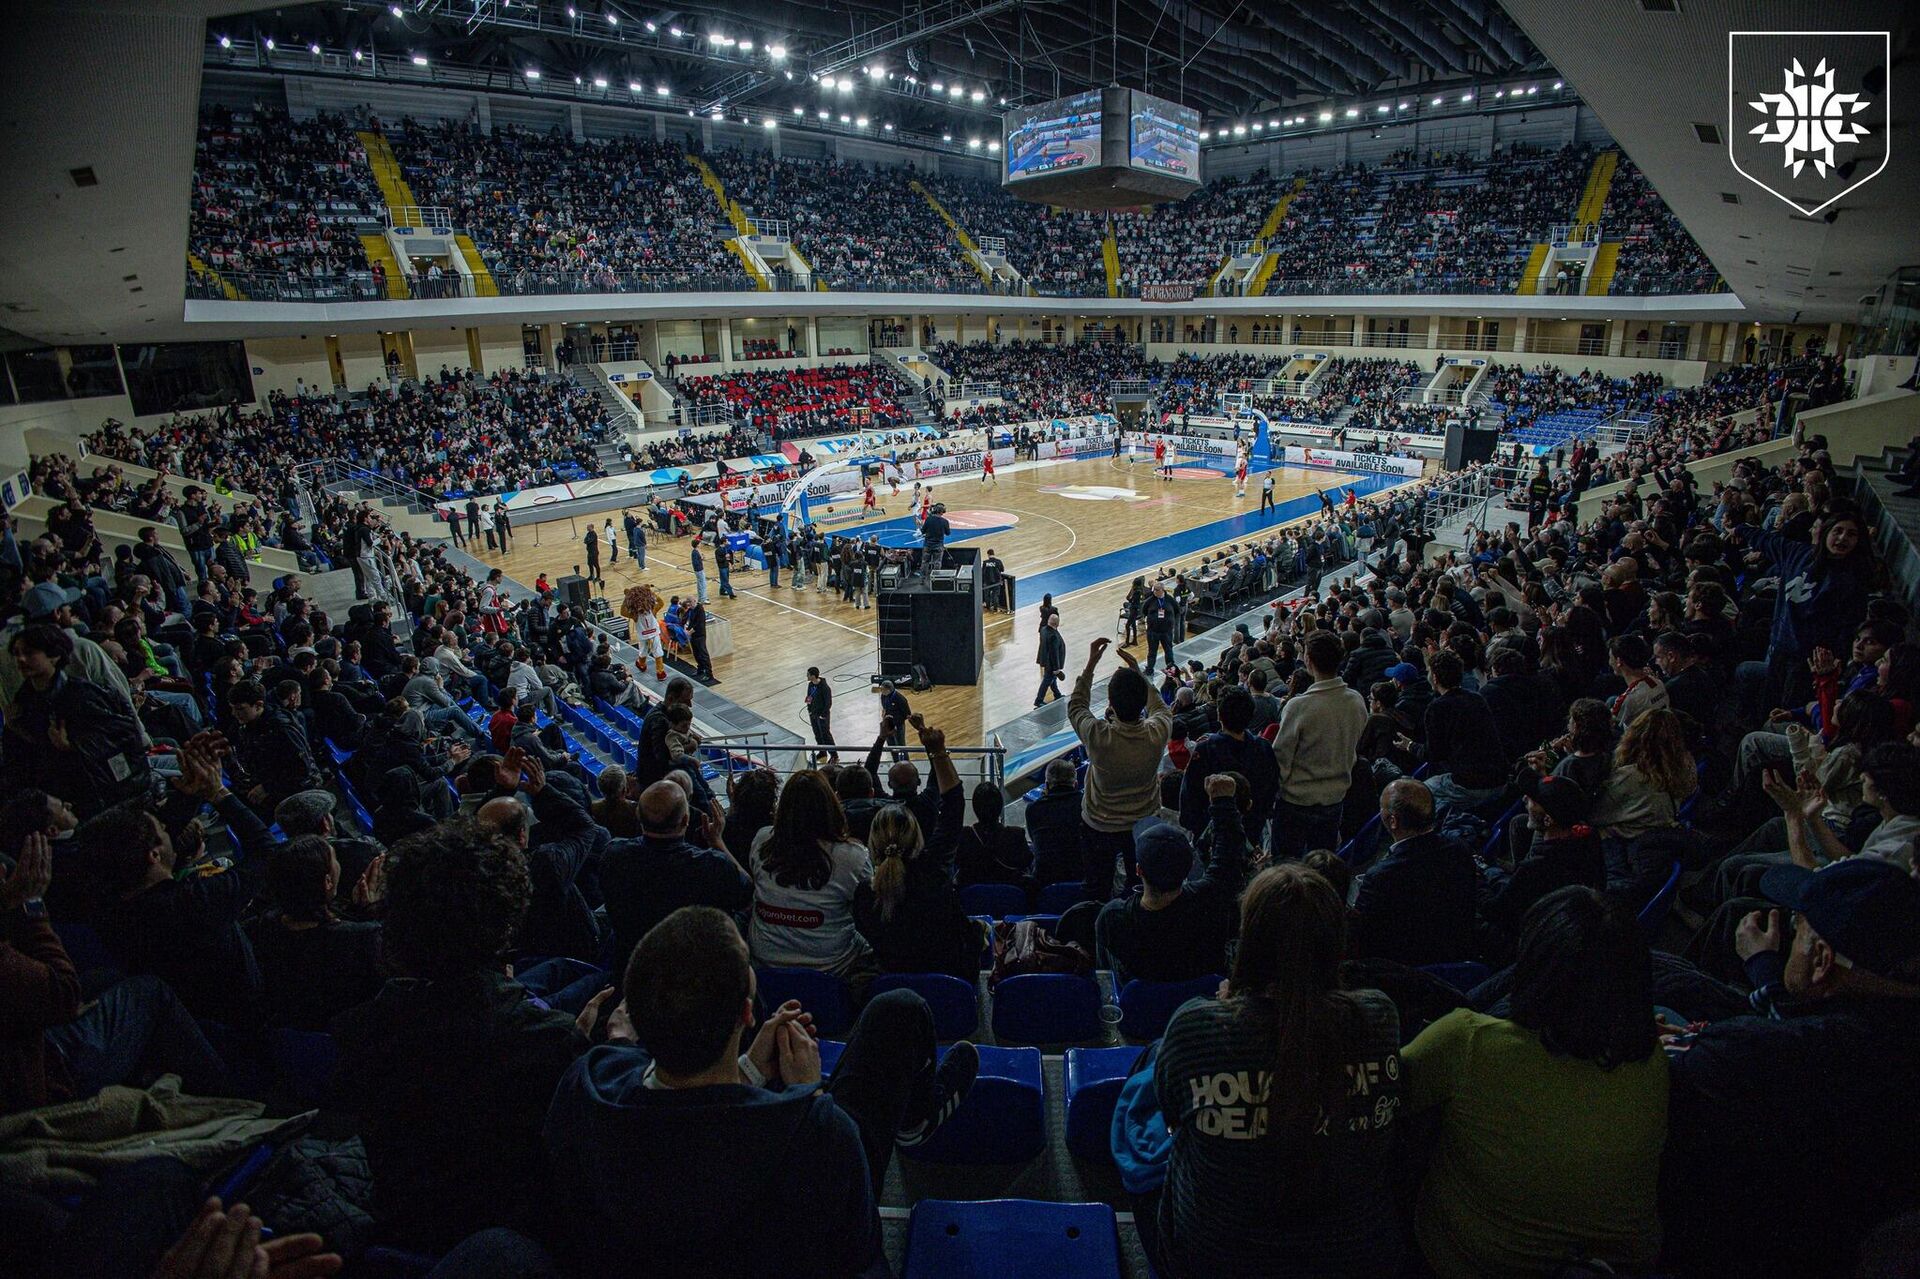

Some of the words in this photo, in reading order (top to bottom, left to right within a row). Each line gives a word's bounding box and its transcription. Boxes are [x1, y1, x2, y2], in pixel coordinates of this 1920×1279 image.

[1181, 437, 1209, 446] TICKETS
[1203, 445, 1223, 454] SOON
[955, 453, 982, 464] TICKETS
[1353, 454, 1388, 465] TICKETS
[941, 461, 977, 474] AVAILABLE
[1335, 459, 1380, 471] AVAILABLE
[1380, 464, 1404, 474] SOON
[807, 484, 830, 496] SOON
